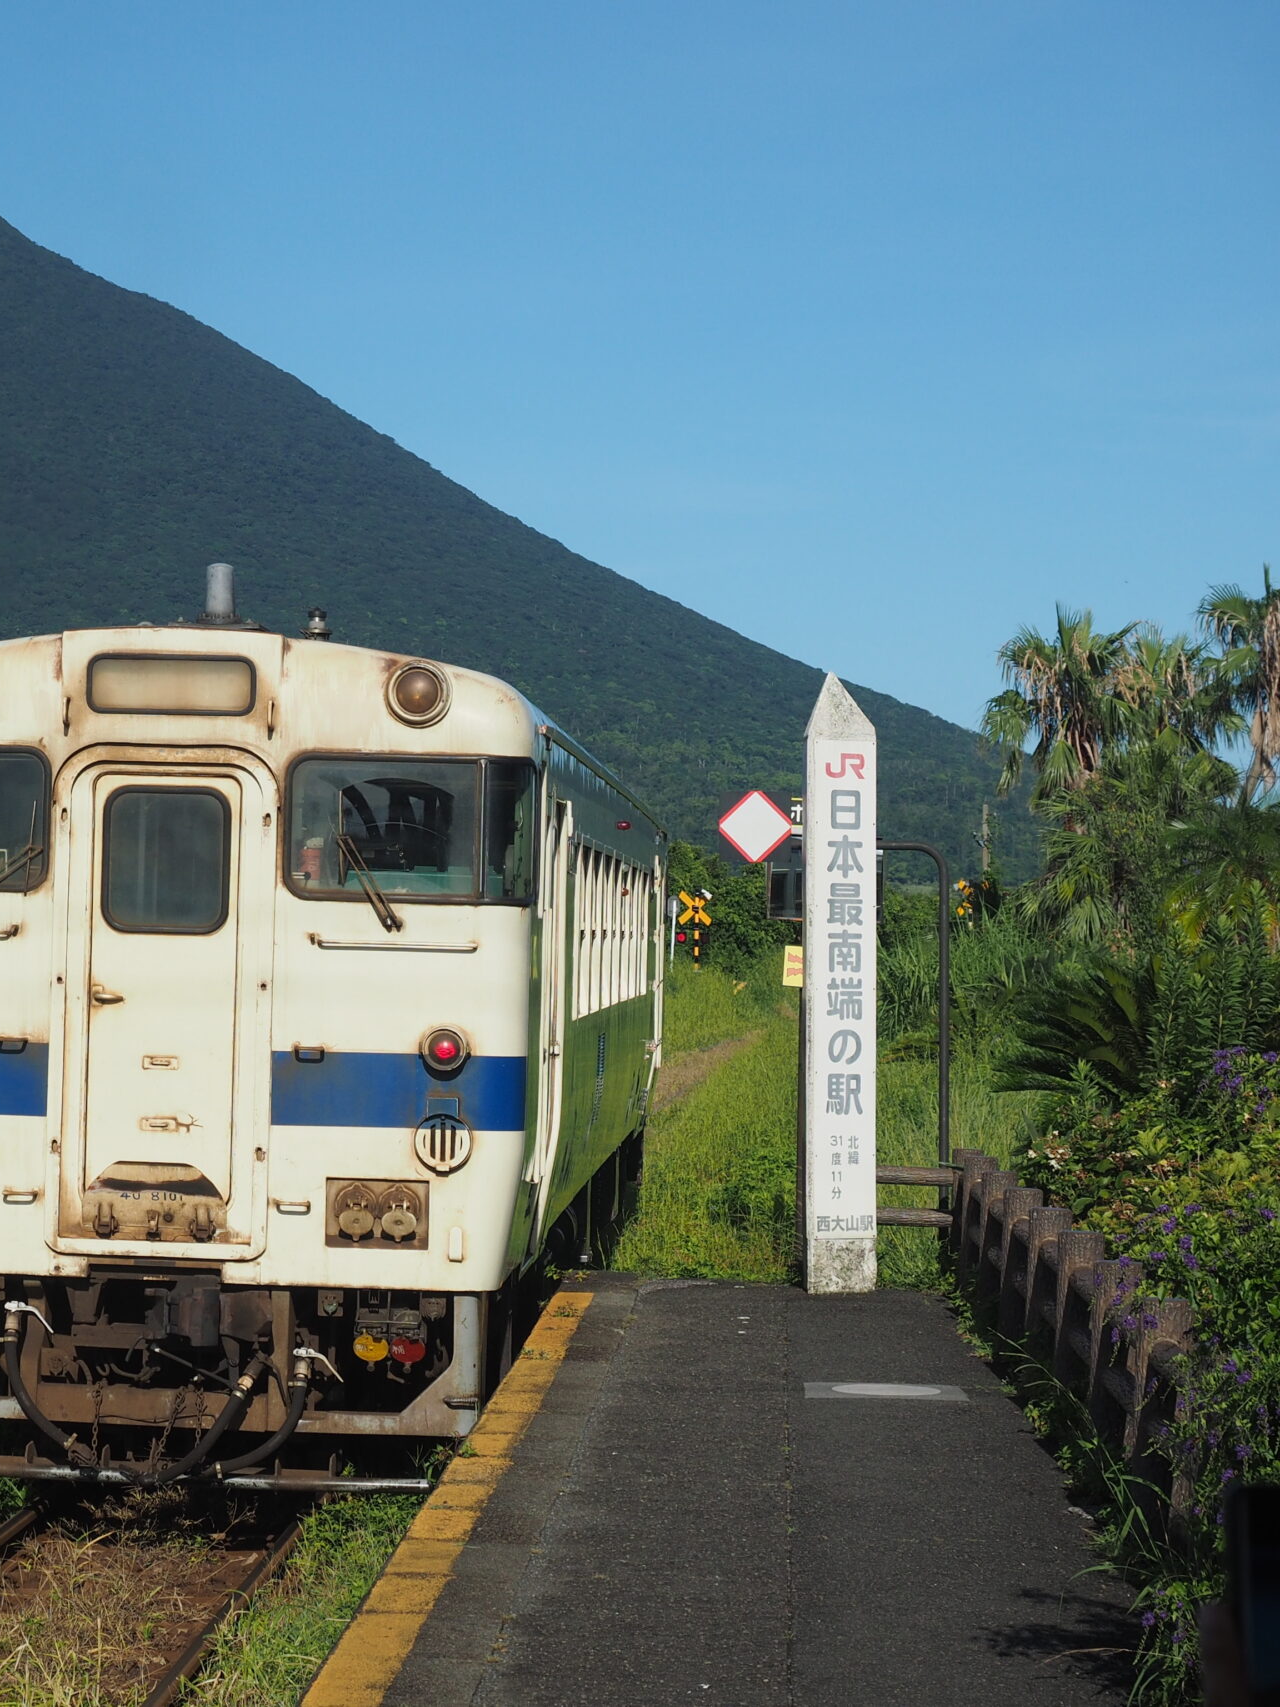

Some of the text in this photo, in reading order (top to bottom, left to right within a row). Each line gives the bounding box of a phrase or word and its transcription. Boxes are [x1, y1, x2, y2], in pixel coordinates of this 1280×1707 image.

[825, 752, 865, 779] JR
[826, 789, 863, 1116] 日本最南端の駅
[847, 1135, 859, 1165] 北緯
[816, 1215, 874, 1233] 西大山駅
